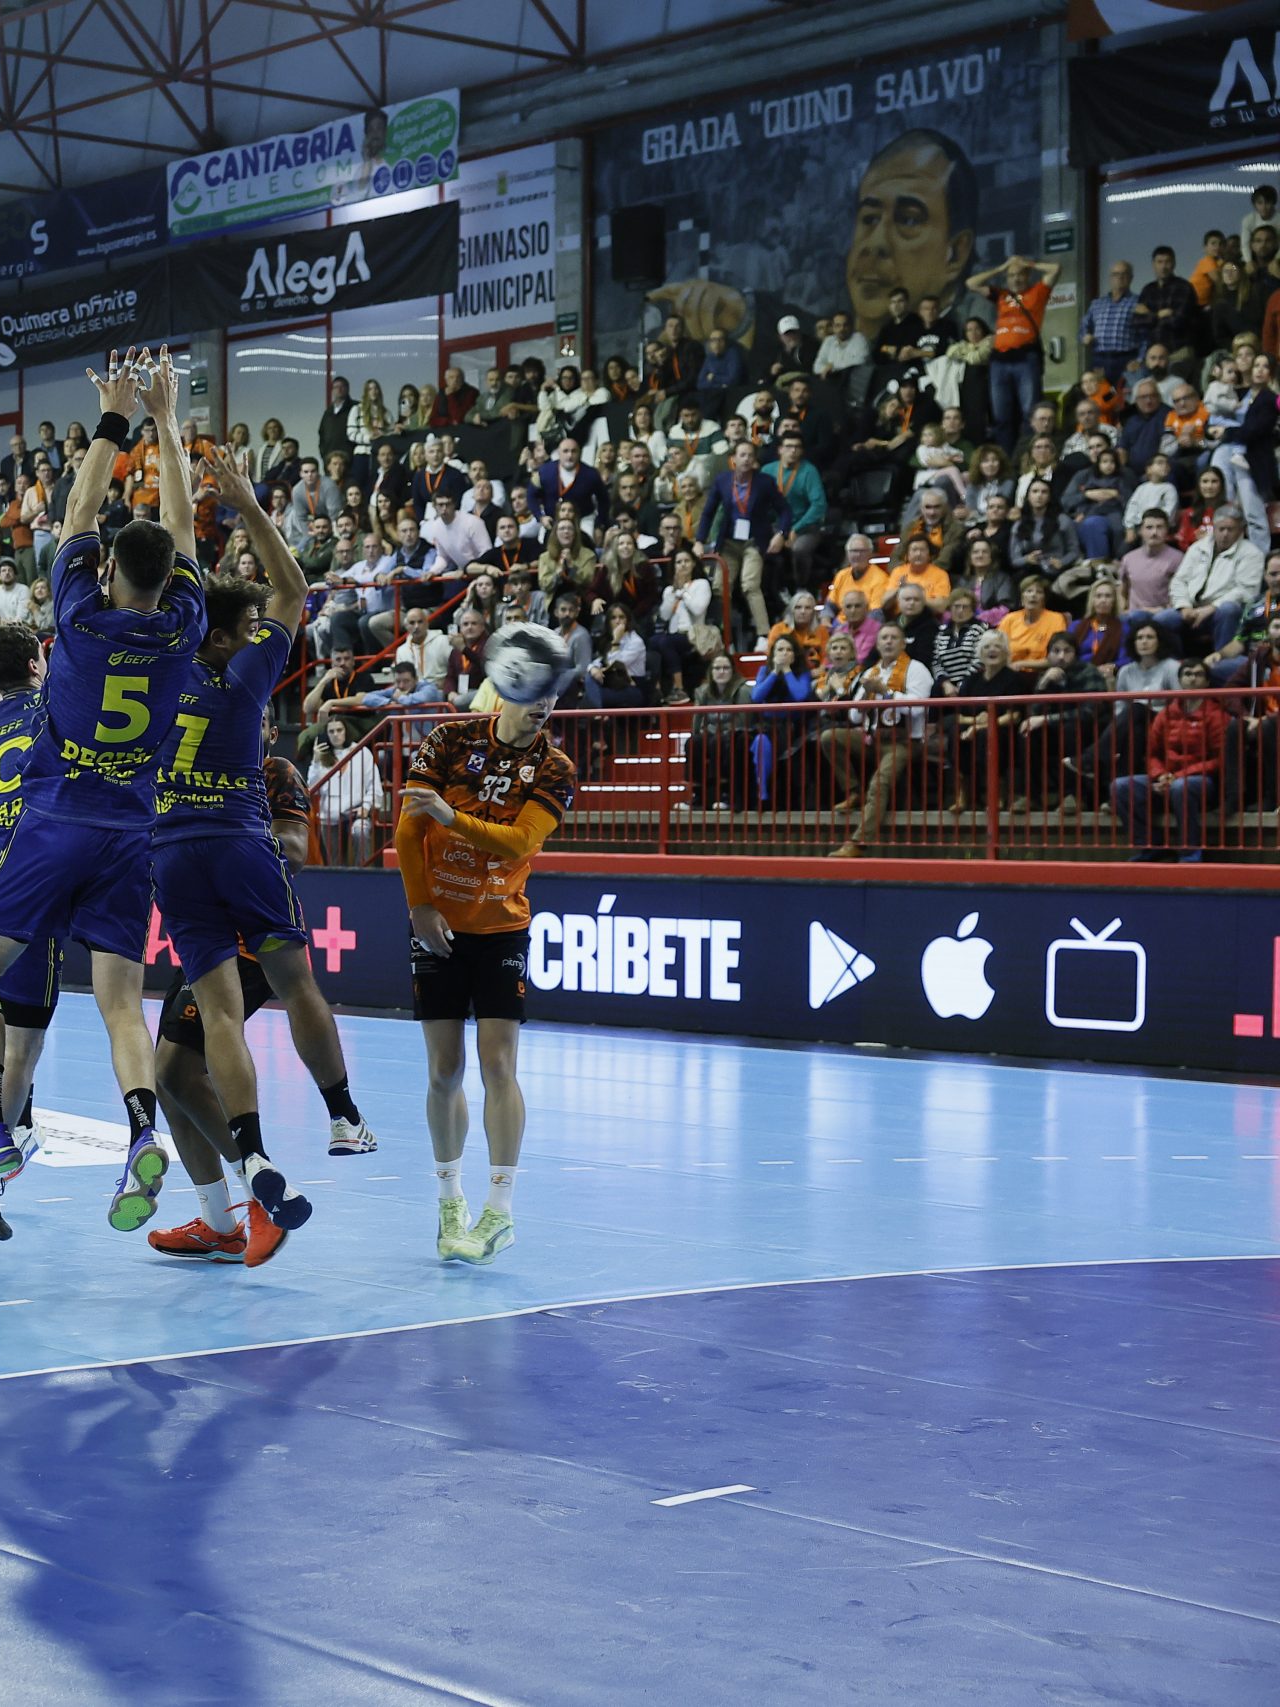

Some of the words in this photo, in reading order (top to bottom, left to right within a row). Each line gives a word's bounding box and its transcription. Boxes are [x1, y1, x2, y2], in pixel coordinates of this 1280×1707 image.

[642, 112, 741, 165] GRADA
[875, 47, 1001, 114] SALVO"
[204, 122, 357, 187] CANTABRIA
[207, 157, 352, 206] TELECOM
[458, 221, 550, 271] GIMNASIO
[452, 268, 555, 320] MUNICIPAL
[124, 655, 159, 665] GEFF
[93, 675, 150, 743] 5
[179, 693, 200, 705] EFF
[478, 774, 512, 805] 32
[527, 893, 742, 1003] CRÍBETE
